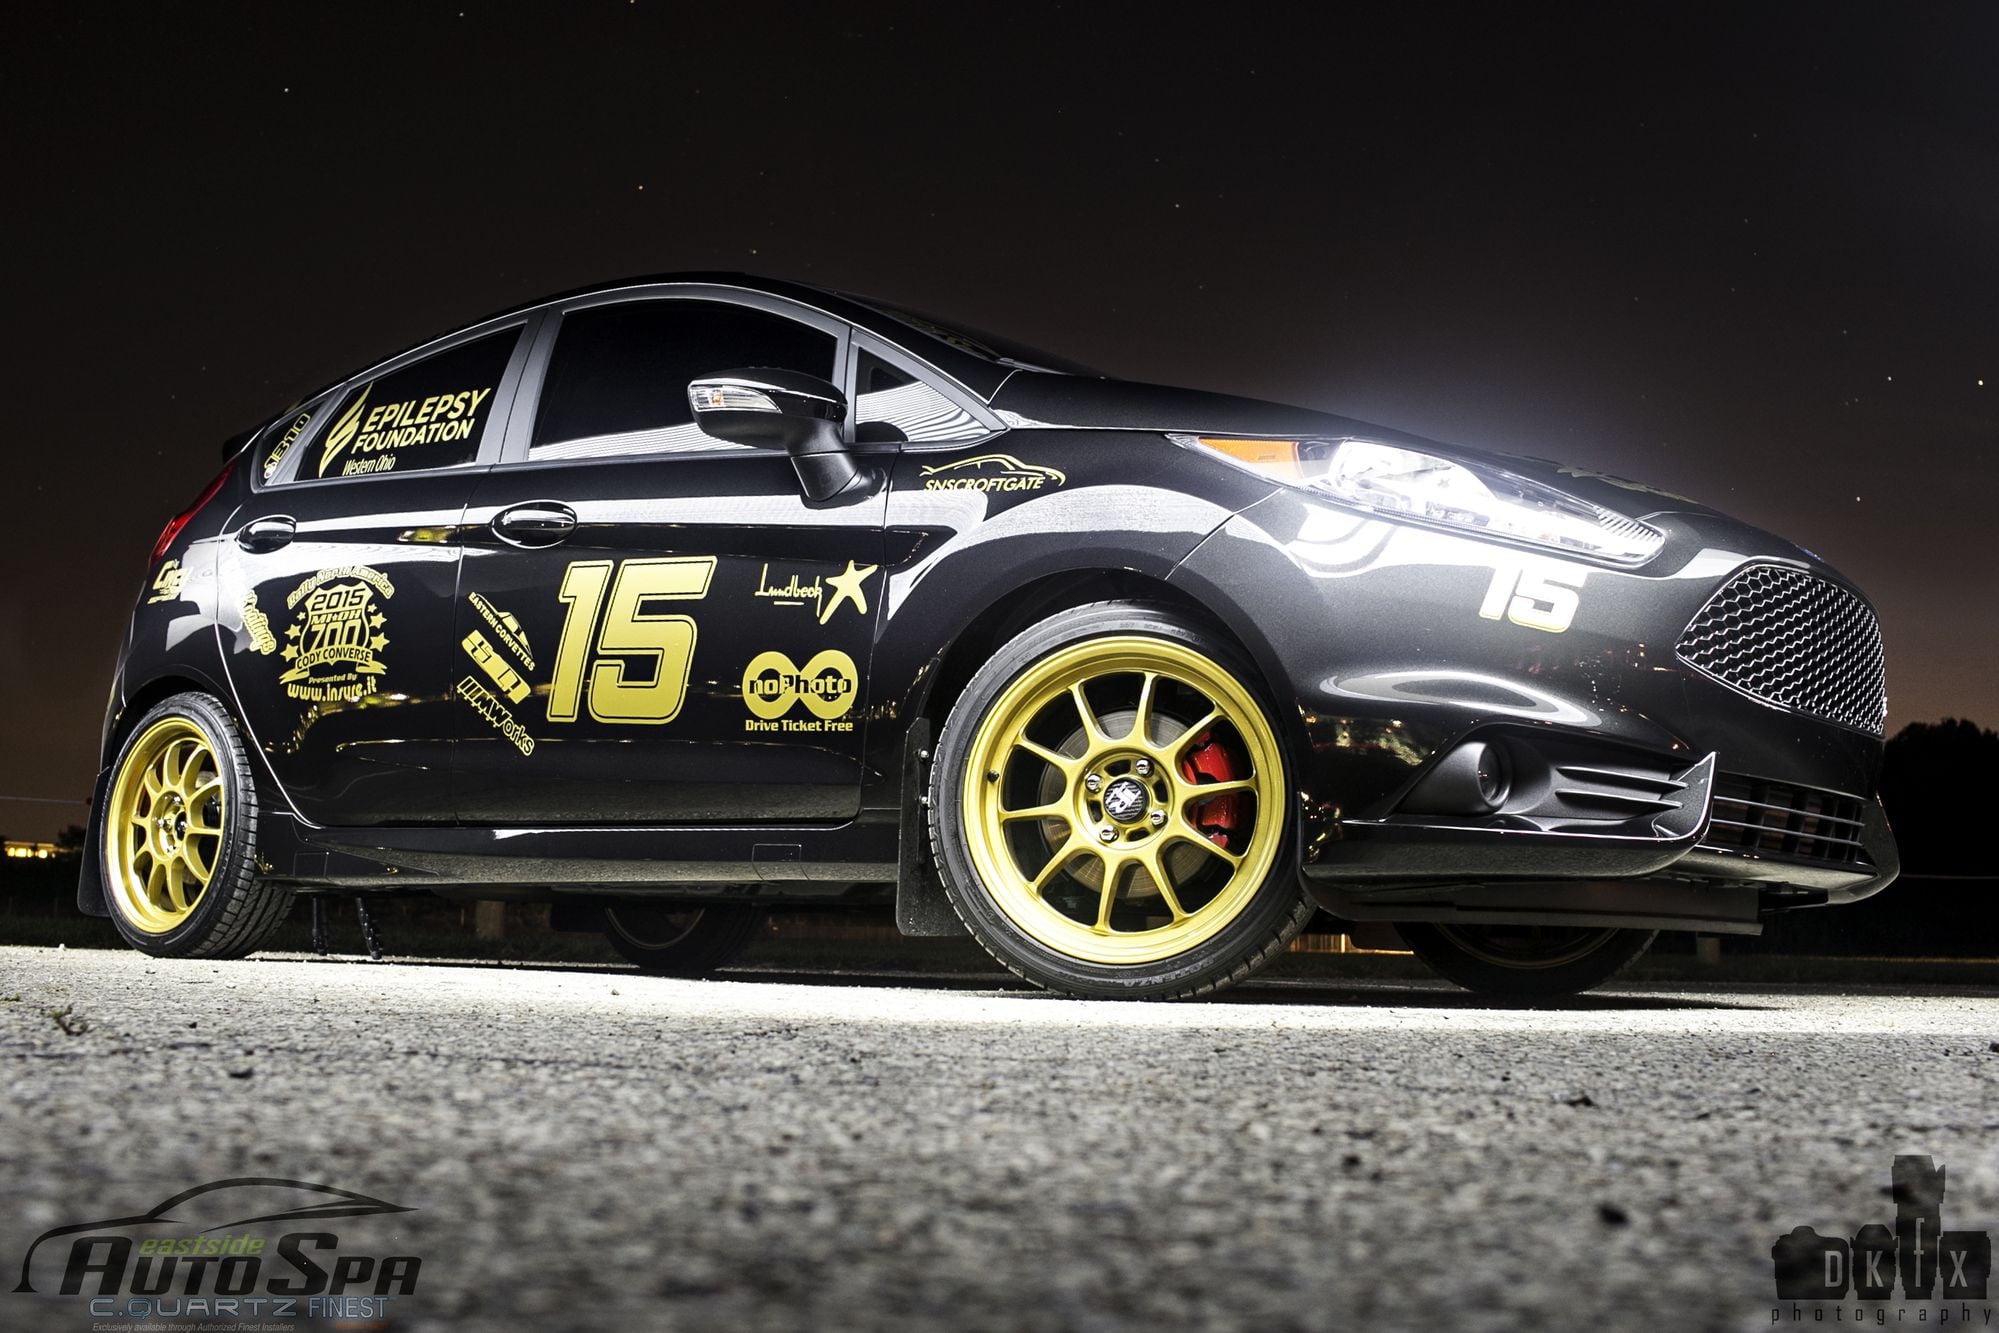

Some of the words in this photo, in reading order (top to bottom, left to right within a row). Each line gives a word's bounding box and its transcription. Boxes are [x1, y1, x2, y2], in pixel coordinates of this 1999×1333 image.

[362, 388, 491, 432] EPILEPSY
[351, 418, 475, 454] FOUNDATION
[342, 458, 376, 476] Western
[375, 453, 396, 472] Ohio
[923, 476, 1046, 492] SNSCROFTGATE
[351, 564, 395, 600] America
[311, 588, 365, 612] 2015
[1478, 563, 1589, 634] 15
[310, 618, 362, 650] 700
[468, 591, 498, 628] EASTERN
[495, 624, 536, 672] CORVETTES
[546, 556, 718, 725] 15
[296, 651, 321, 670] CODY
[322, 647, 371, 663] CONVERSE
[308, 674, 346, 685] Presented
[347, 672, 358, 682] By
[749, 675, 852, 695] noPhoto
[745, 719, 779, 732] Drive
[781, 719, 821, 732] Ticket
[824, 719, 854, 732] Free
